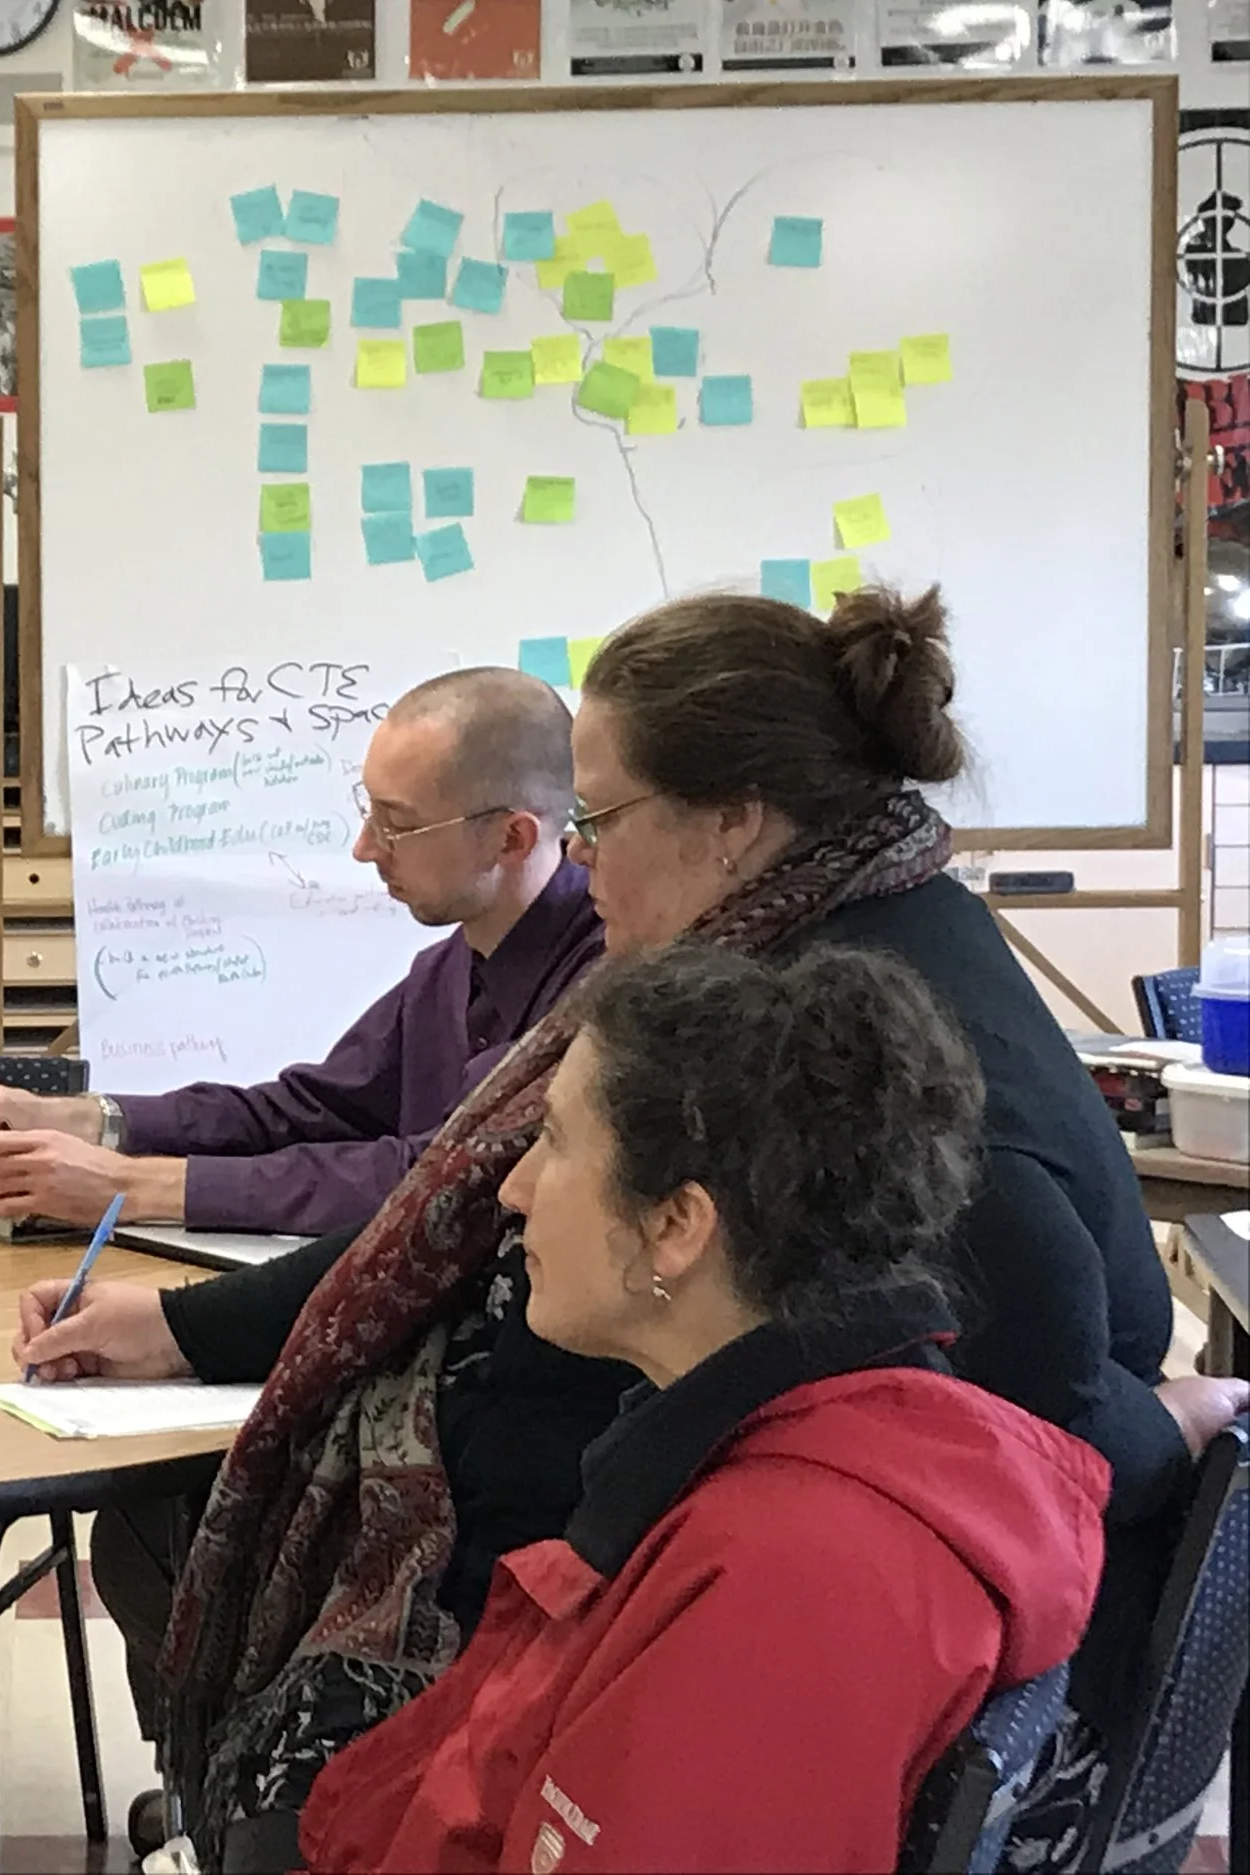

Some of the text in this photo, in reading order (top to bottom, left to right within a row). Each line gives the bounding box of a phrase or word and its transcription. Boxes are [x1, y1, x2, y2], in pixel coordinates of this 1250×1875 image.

[85, 662, 371, 716] Ideas for CTE
[75, 717, 260, 765] Pathways
[170, 799, 231, 829] Program
